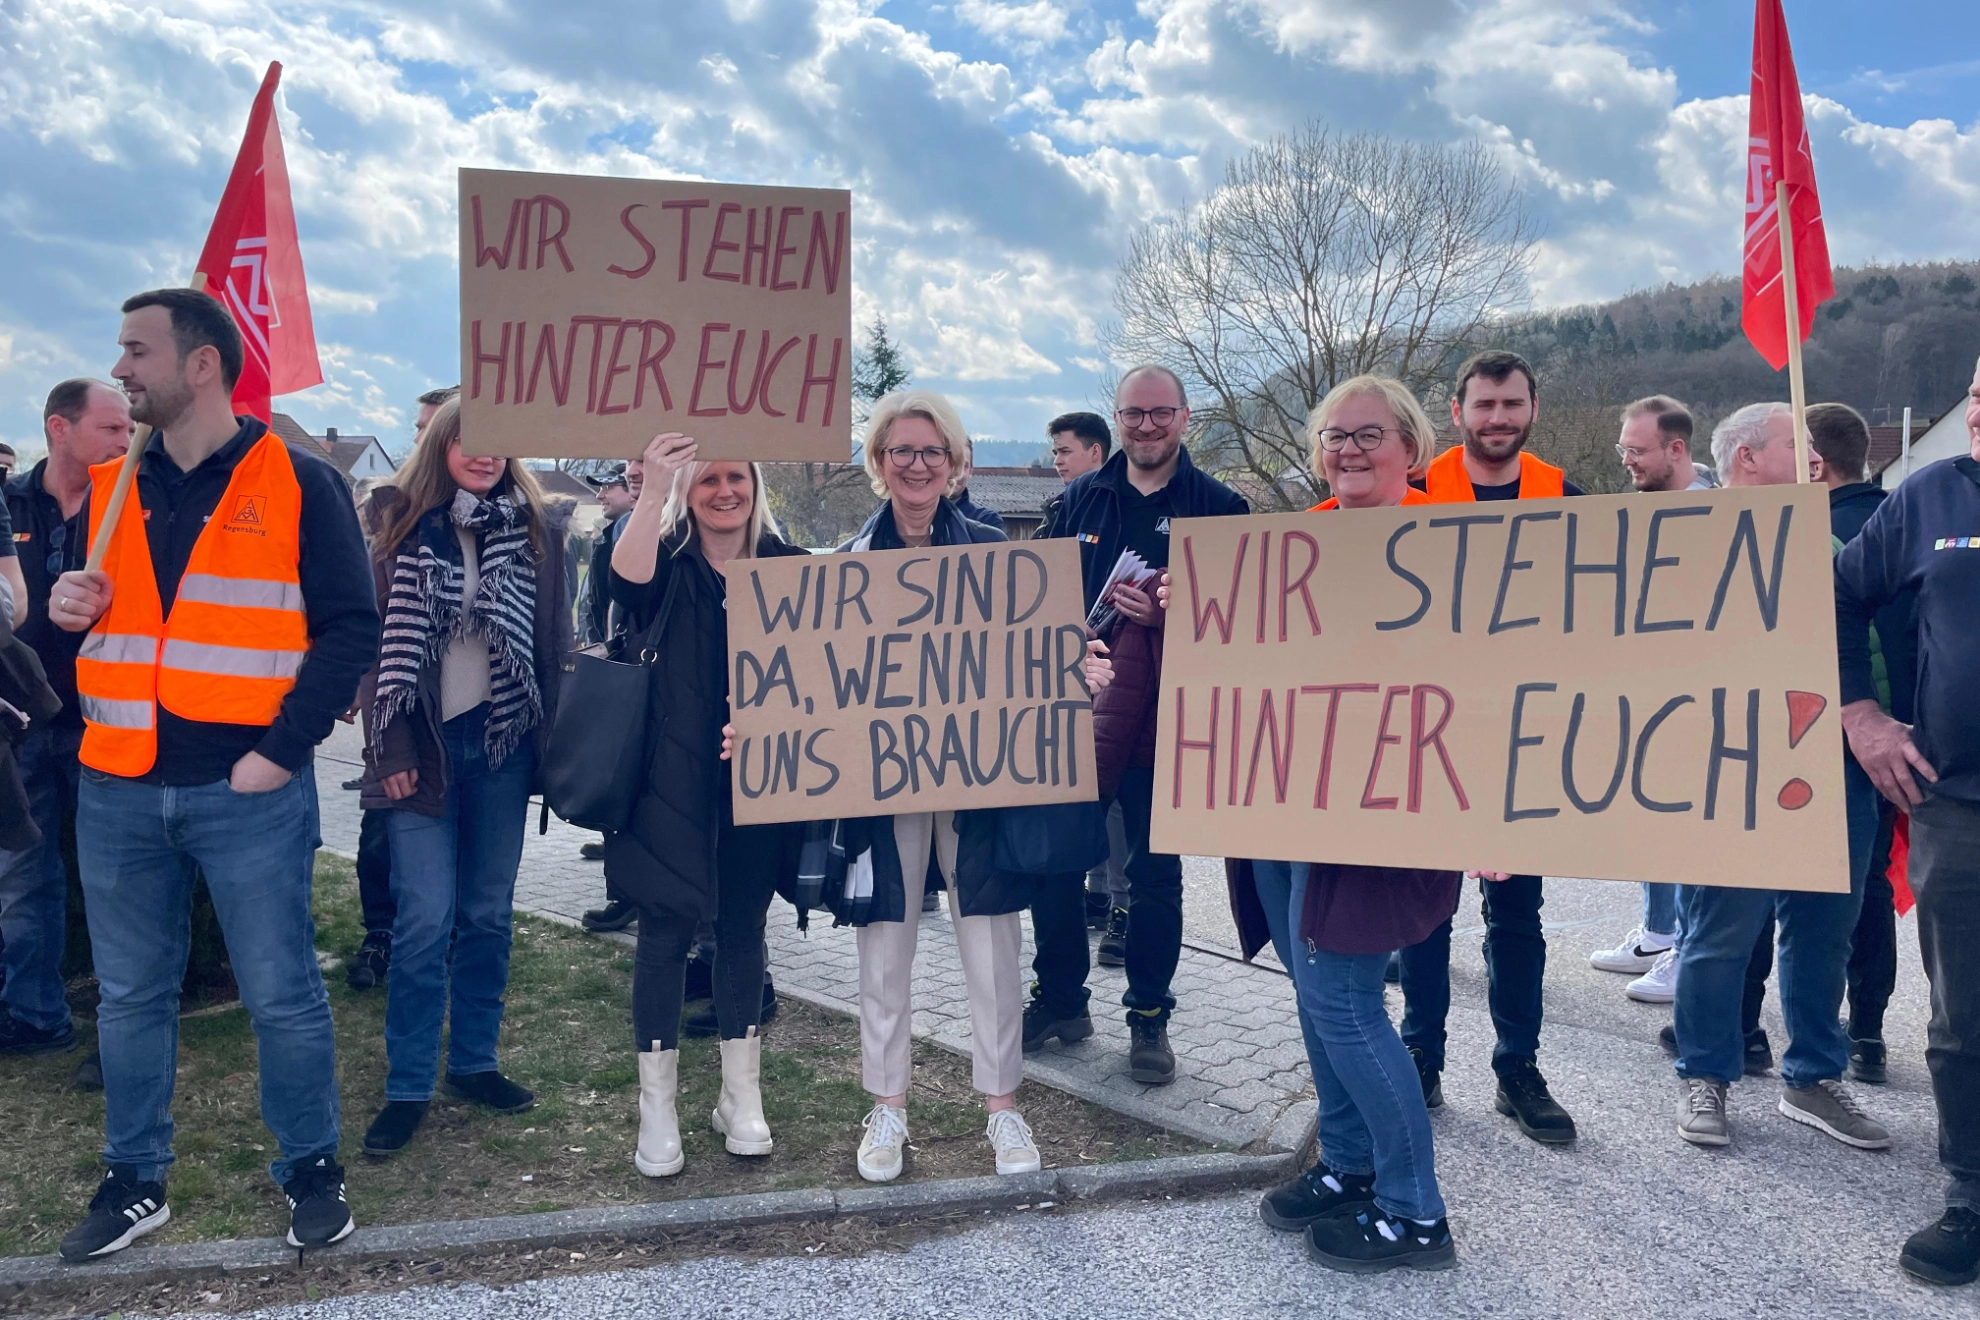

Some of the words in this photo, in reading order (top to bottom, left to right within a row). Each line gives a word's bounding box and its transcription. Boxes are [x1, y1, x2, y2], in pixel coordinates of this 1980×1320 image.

[471, 194, 575, 273] WIR
[606, 198, 847, 295] STEHEN
[471, 315, 676, 416] HINTER
[688, 322, 842, 427] EUCH
[223, 524, 266, 536] Regensburg
[1183, 530, 1322, 644] WIR
[1375, 504, 1794, 636] STEHEN
[750, 560, 872, 635] WIR
[897, 549, 1048, 627] SIND
[735, 644, 814, 715] DA,
[824, 629, 988, 709] WENN
[1005, 624, 1092, 700] IHR
[739, 727, 840, 799] UNS
[868, 700, 1093, 801] BRAUCHT
[1172, 682, 1471, 814] HINTER
[1503, 681, 1827, 831] EUCH!
